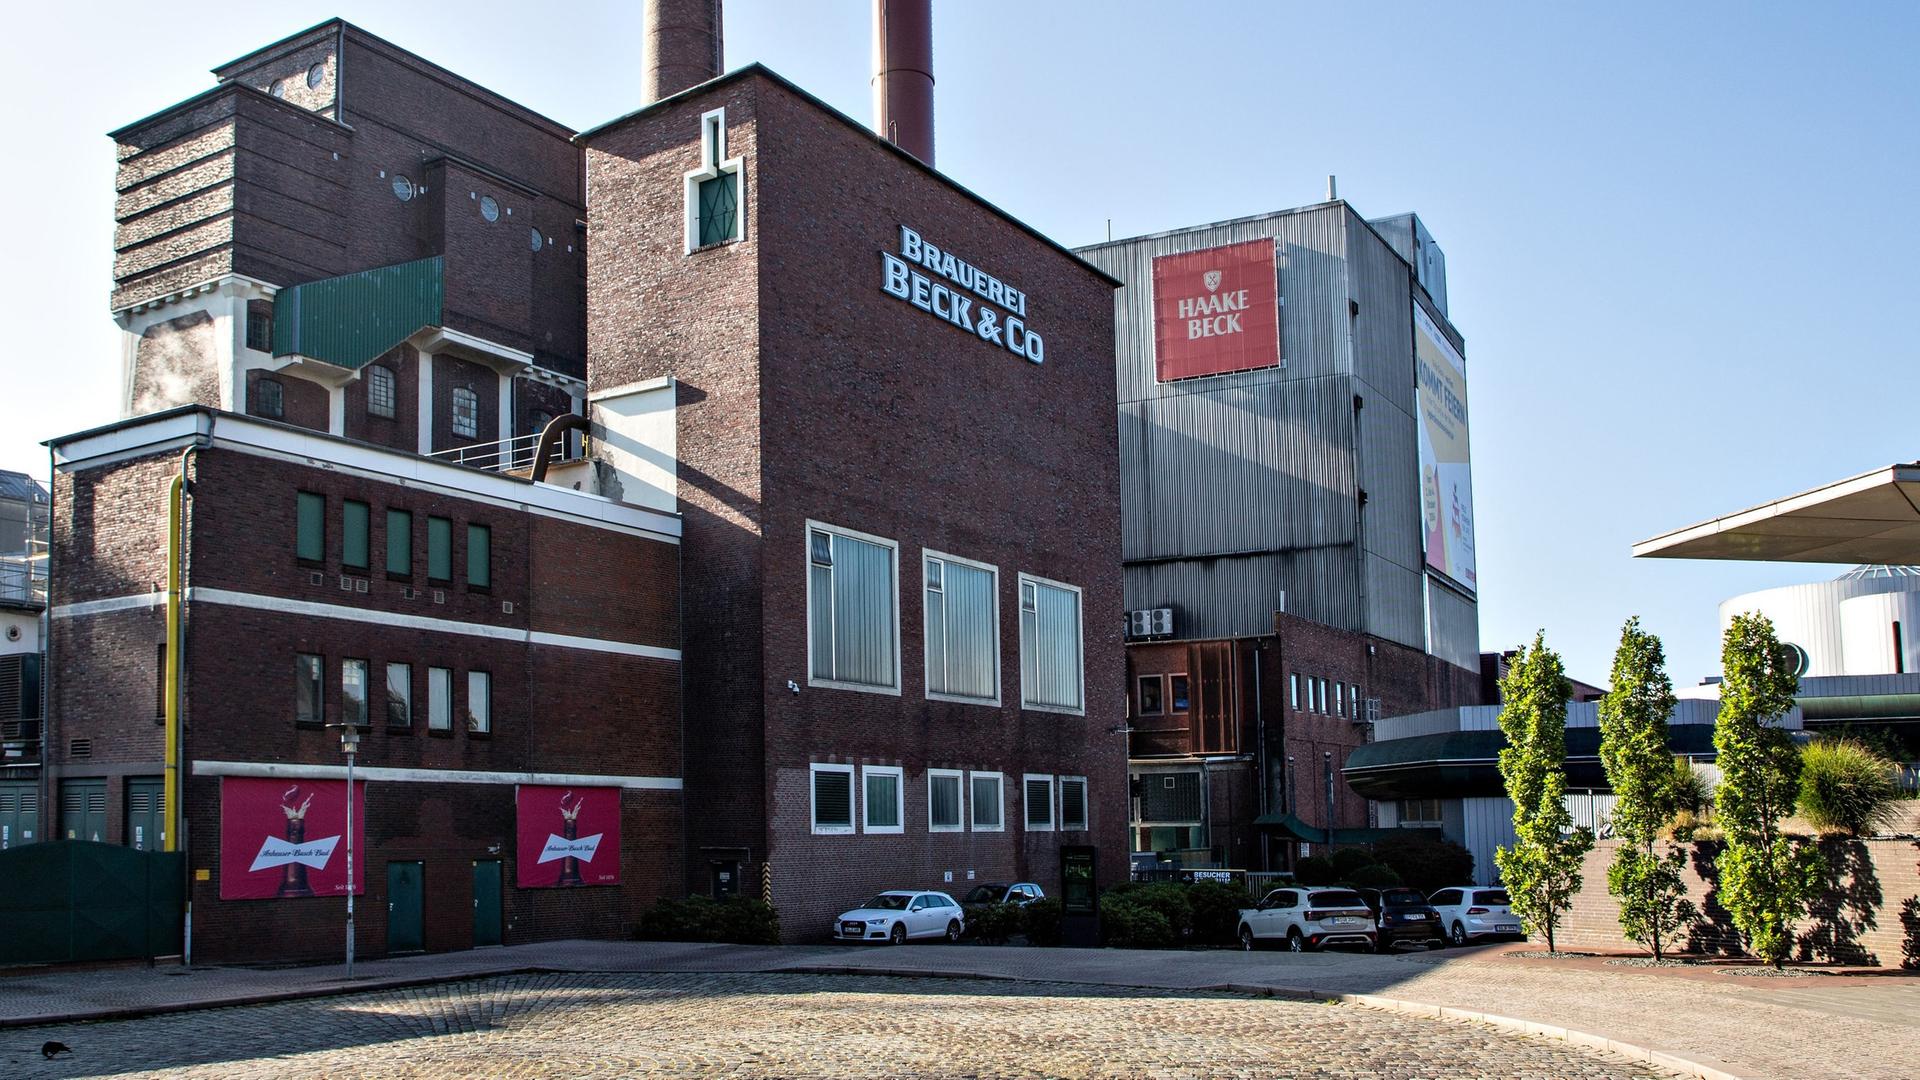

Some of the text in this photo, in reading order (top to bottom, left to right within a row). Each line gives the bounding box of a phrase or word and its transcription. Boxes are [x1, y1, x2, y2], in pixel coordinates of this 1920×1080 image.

[881, 251, 975, 334] BECK
[976, 306, 1004, 347] &
[900, 225, 1026, 318] BRAUEREI
[1178, 289, 1250, 319] HAAKE
[1188, 313, 1243, 340] BECK
